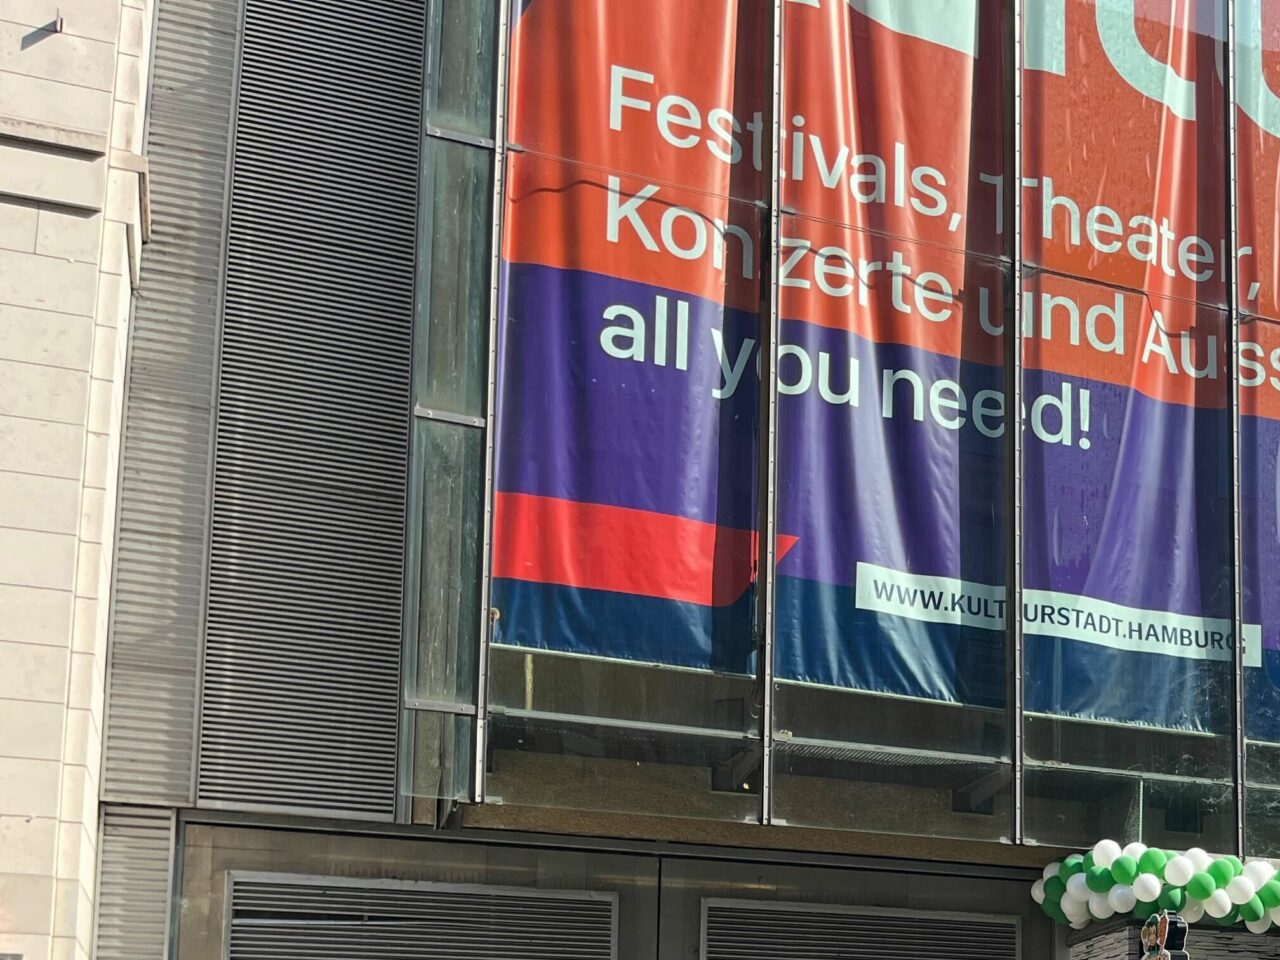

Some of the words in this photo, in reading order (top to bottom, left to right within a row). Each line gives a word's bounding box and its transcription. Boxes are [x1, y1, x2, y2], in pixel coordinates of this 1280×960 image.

[606, 176, 953, 322] Konzerte
[979, 287, 1124, 355] und
[609, 65, 962, 231] Festivals,
[979, 172, 1261, 300] Theater,
[600, 295, 688, 371] all
[711, 327, 860, 408] you
[882, 367, 1091, 450] need!
